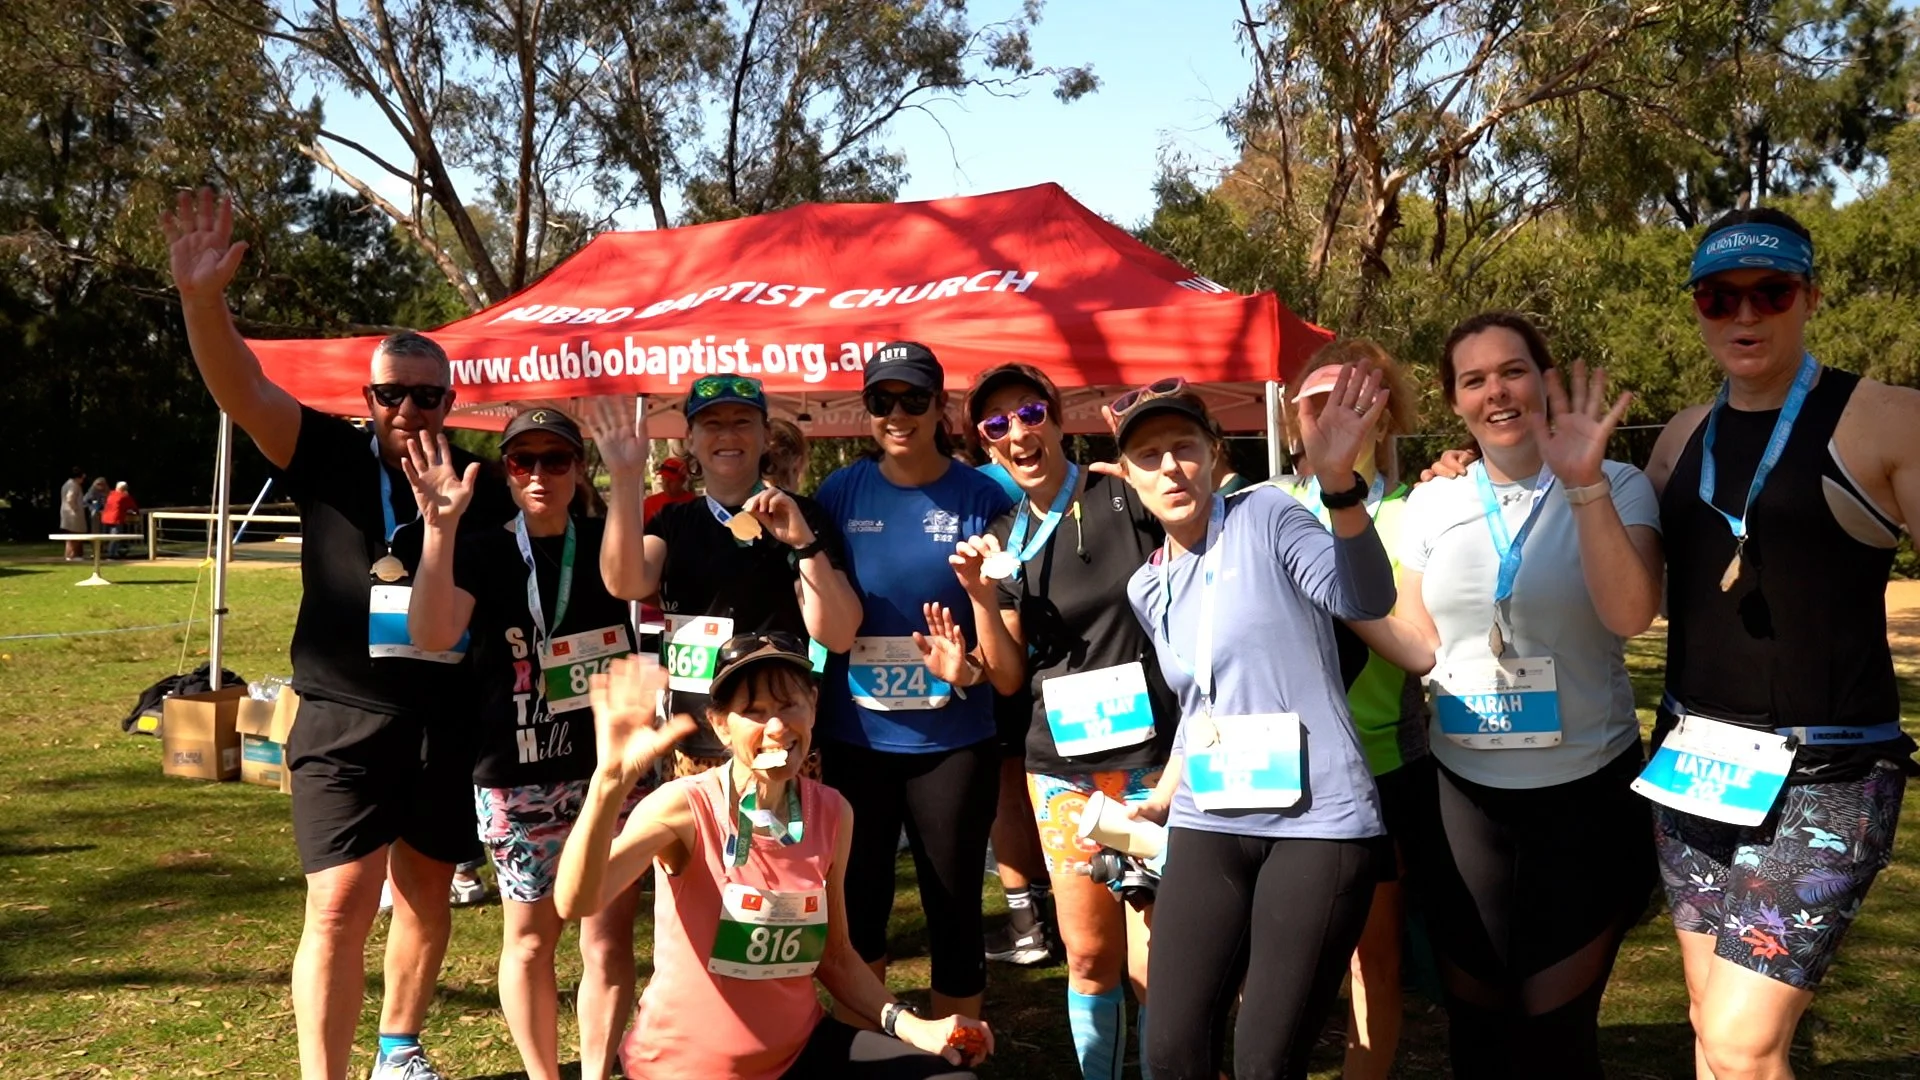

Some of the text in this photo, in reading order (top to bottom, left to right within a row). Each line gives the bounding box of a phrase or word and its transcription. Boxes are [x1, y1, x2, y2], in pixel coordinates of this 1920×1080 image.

[634, 281, 827, 319] BAPTIST
[828, 270, 1040, 310] CHURCH
[667, 644, 708, 677] 869
[871, 666, 927, 697] 324
[1465, 694, 1523, 714] SARAH
[1478, 714, 1513, 732] 266
[516, 720, 573, 764] Hills
[1674, 752, 1757, 789] NATALIE
[746, 927, 802, 963] 816
